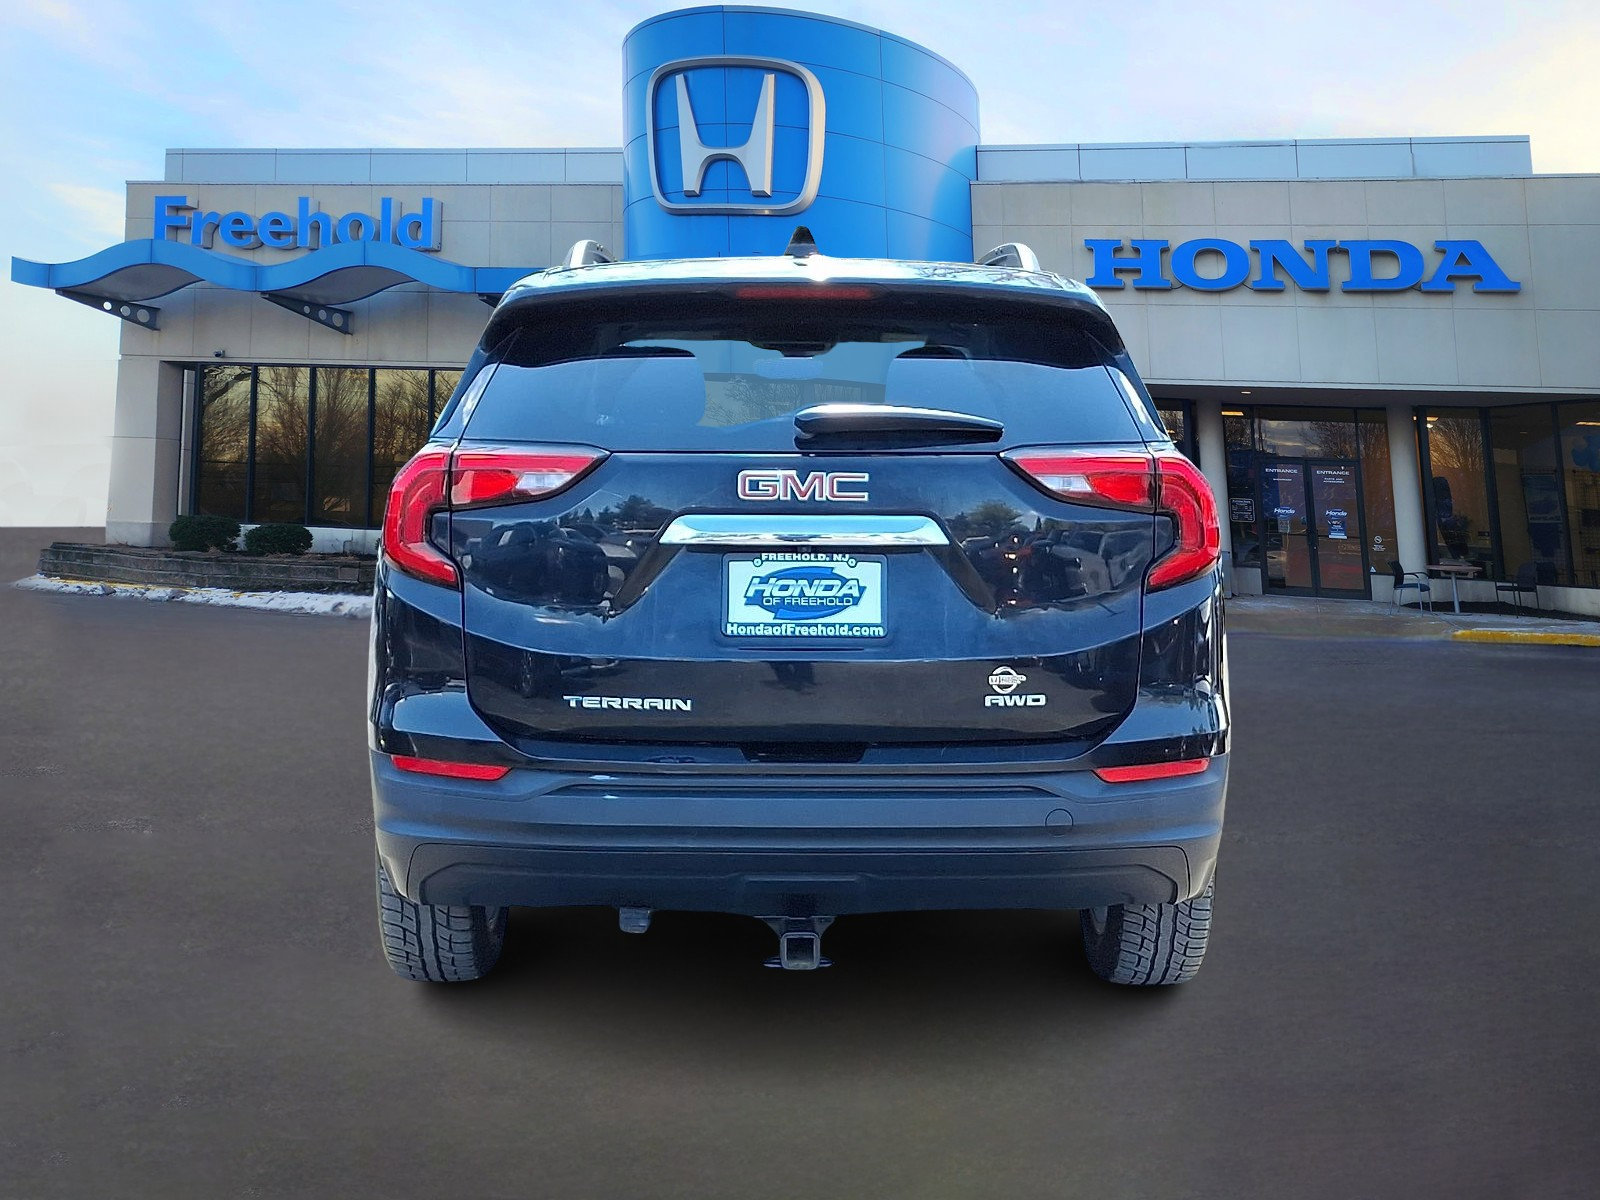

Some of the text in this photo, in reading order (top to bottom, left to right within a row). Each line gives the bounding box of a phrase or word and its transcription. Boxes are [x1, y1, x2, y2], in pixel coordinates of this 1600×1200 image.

[154, 196, 441, 250] Freehold
[1084, 239, 1521, 293] HONDA
[737, 469, 869, 502] GMC
[1273, 507, 1296, 515] Honda
[832, 553, 849, 562] NJ
[745, 576, 861, 597] HONDA
[763, 597, 853, 606] OF FREEHOLD
[726, 623, 884, 637] HondaofFreehold.com
[563, 695, 693, 712] TERRAIN
[984, 694, 1047, 707] AWD
